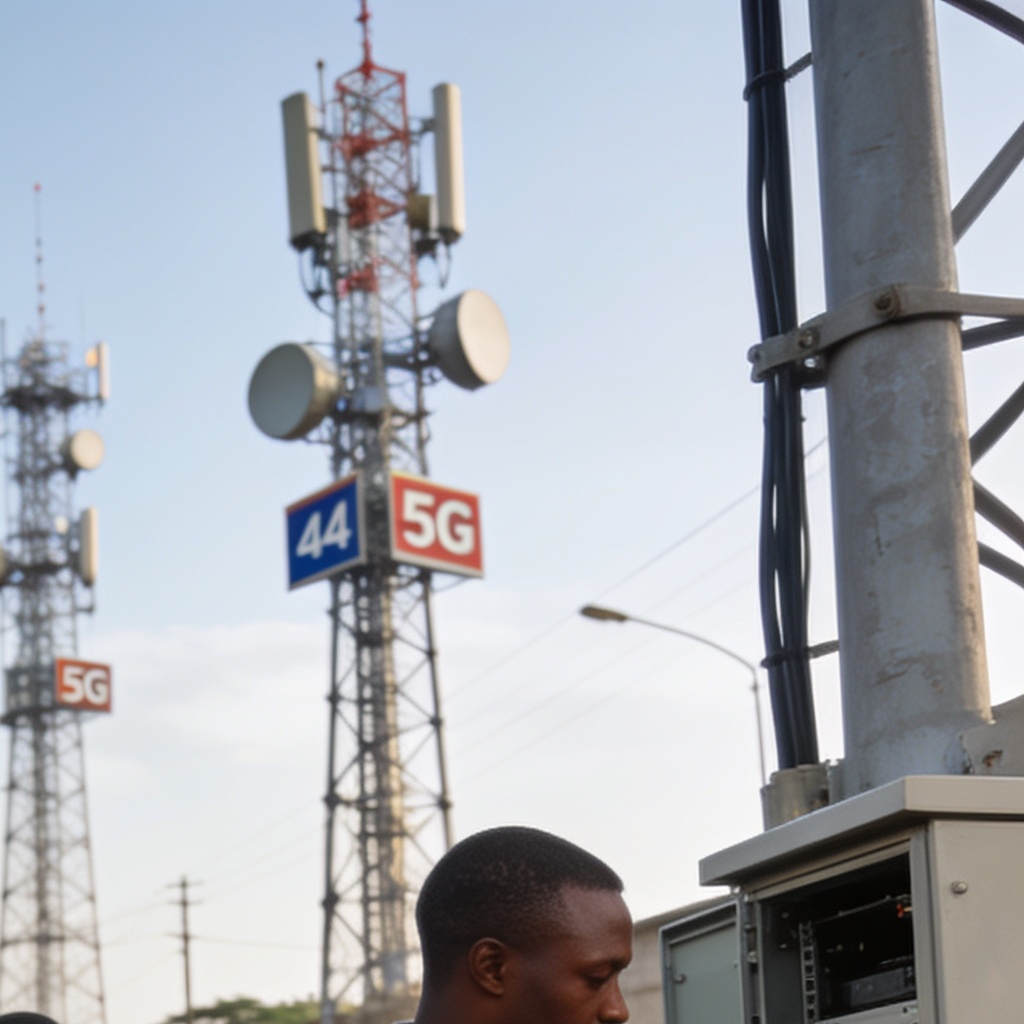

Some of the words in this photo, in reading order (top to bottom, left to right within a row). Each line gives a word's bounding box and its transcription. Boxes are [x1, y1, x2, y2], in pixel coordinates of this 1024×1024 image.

[296, 500, 351, 558] 44
[402, 489, 475, 555] 5G
[62, 665, 108, 705] 5G
